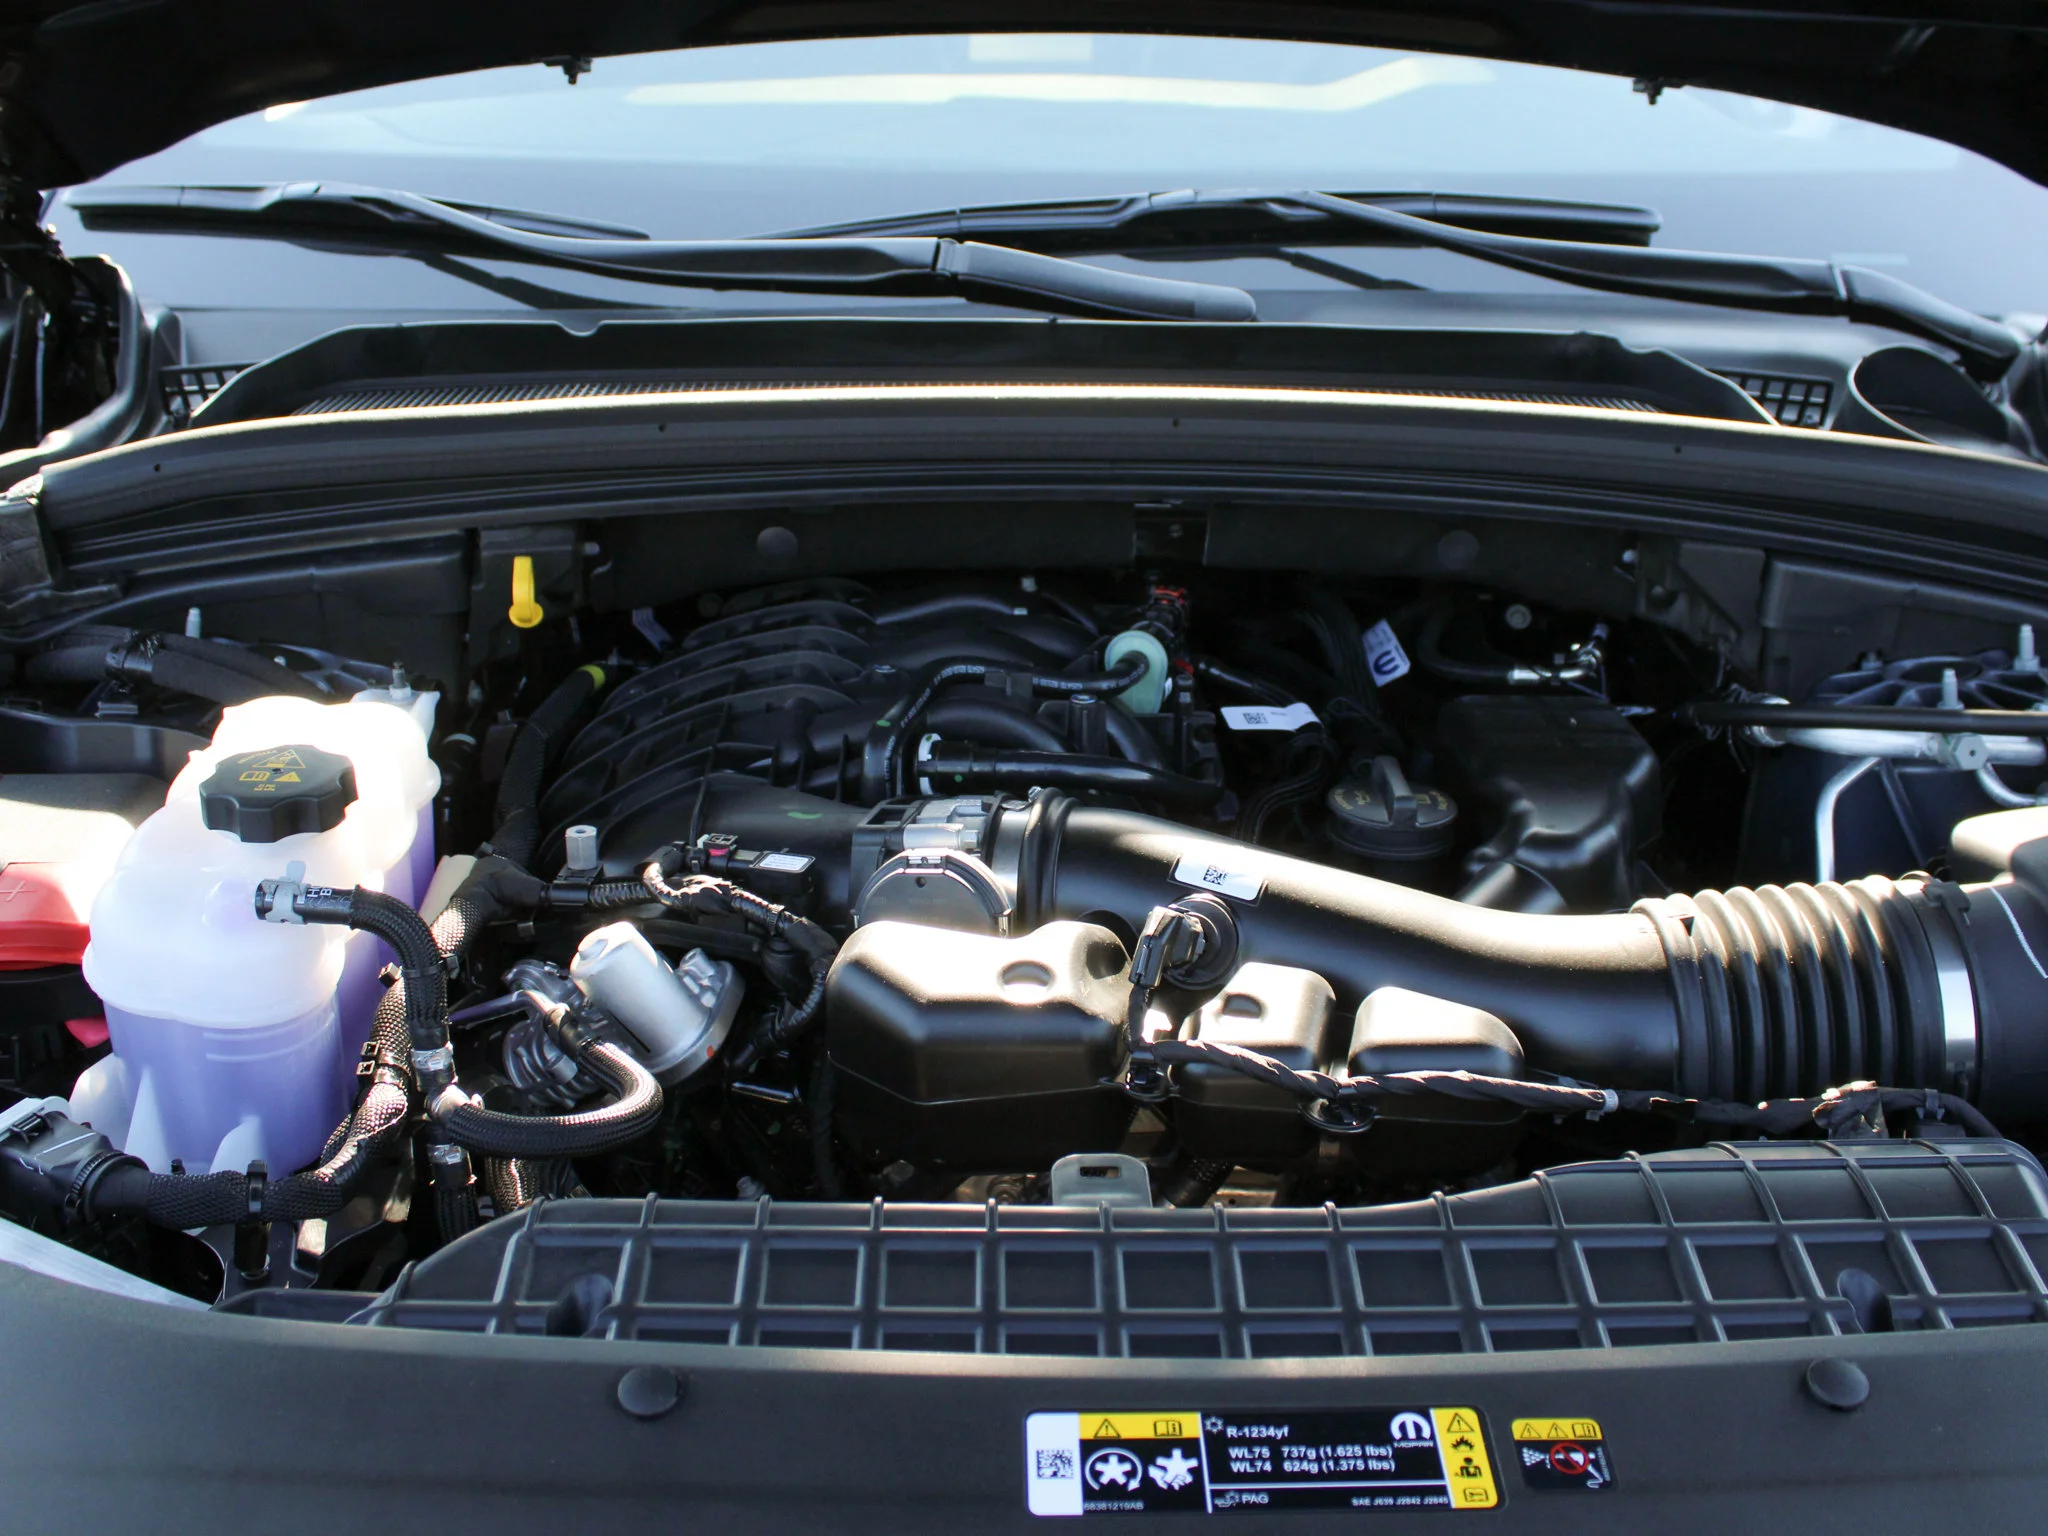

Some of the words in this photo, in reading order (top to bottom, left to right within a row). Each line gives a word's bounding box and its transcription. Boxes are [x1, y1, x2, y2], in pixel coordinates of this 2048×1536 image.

[1226, 1425, 1289, 1440] R-1234yf
[1228, 1446, 1270, 1459] WL75
[1281, 1446, 1316, 1460] 737g
[1320, 1444, 1362, 1459] (1.625
[1365, 1444, 1393, 1458] lbs)
[1230, 1460, 1272, 1473] WL74
[1283, 1460, 1318, 1474] 624g
[1322, 1459, 1365, 1474] (1.375
[1368, 1458, 1395, 1473] lbs)
[1241, 1491, 1269, 1504] PAG
[1351, 1496, 1371, 1506] SAE
